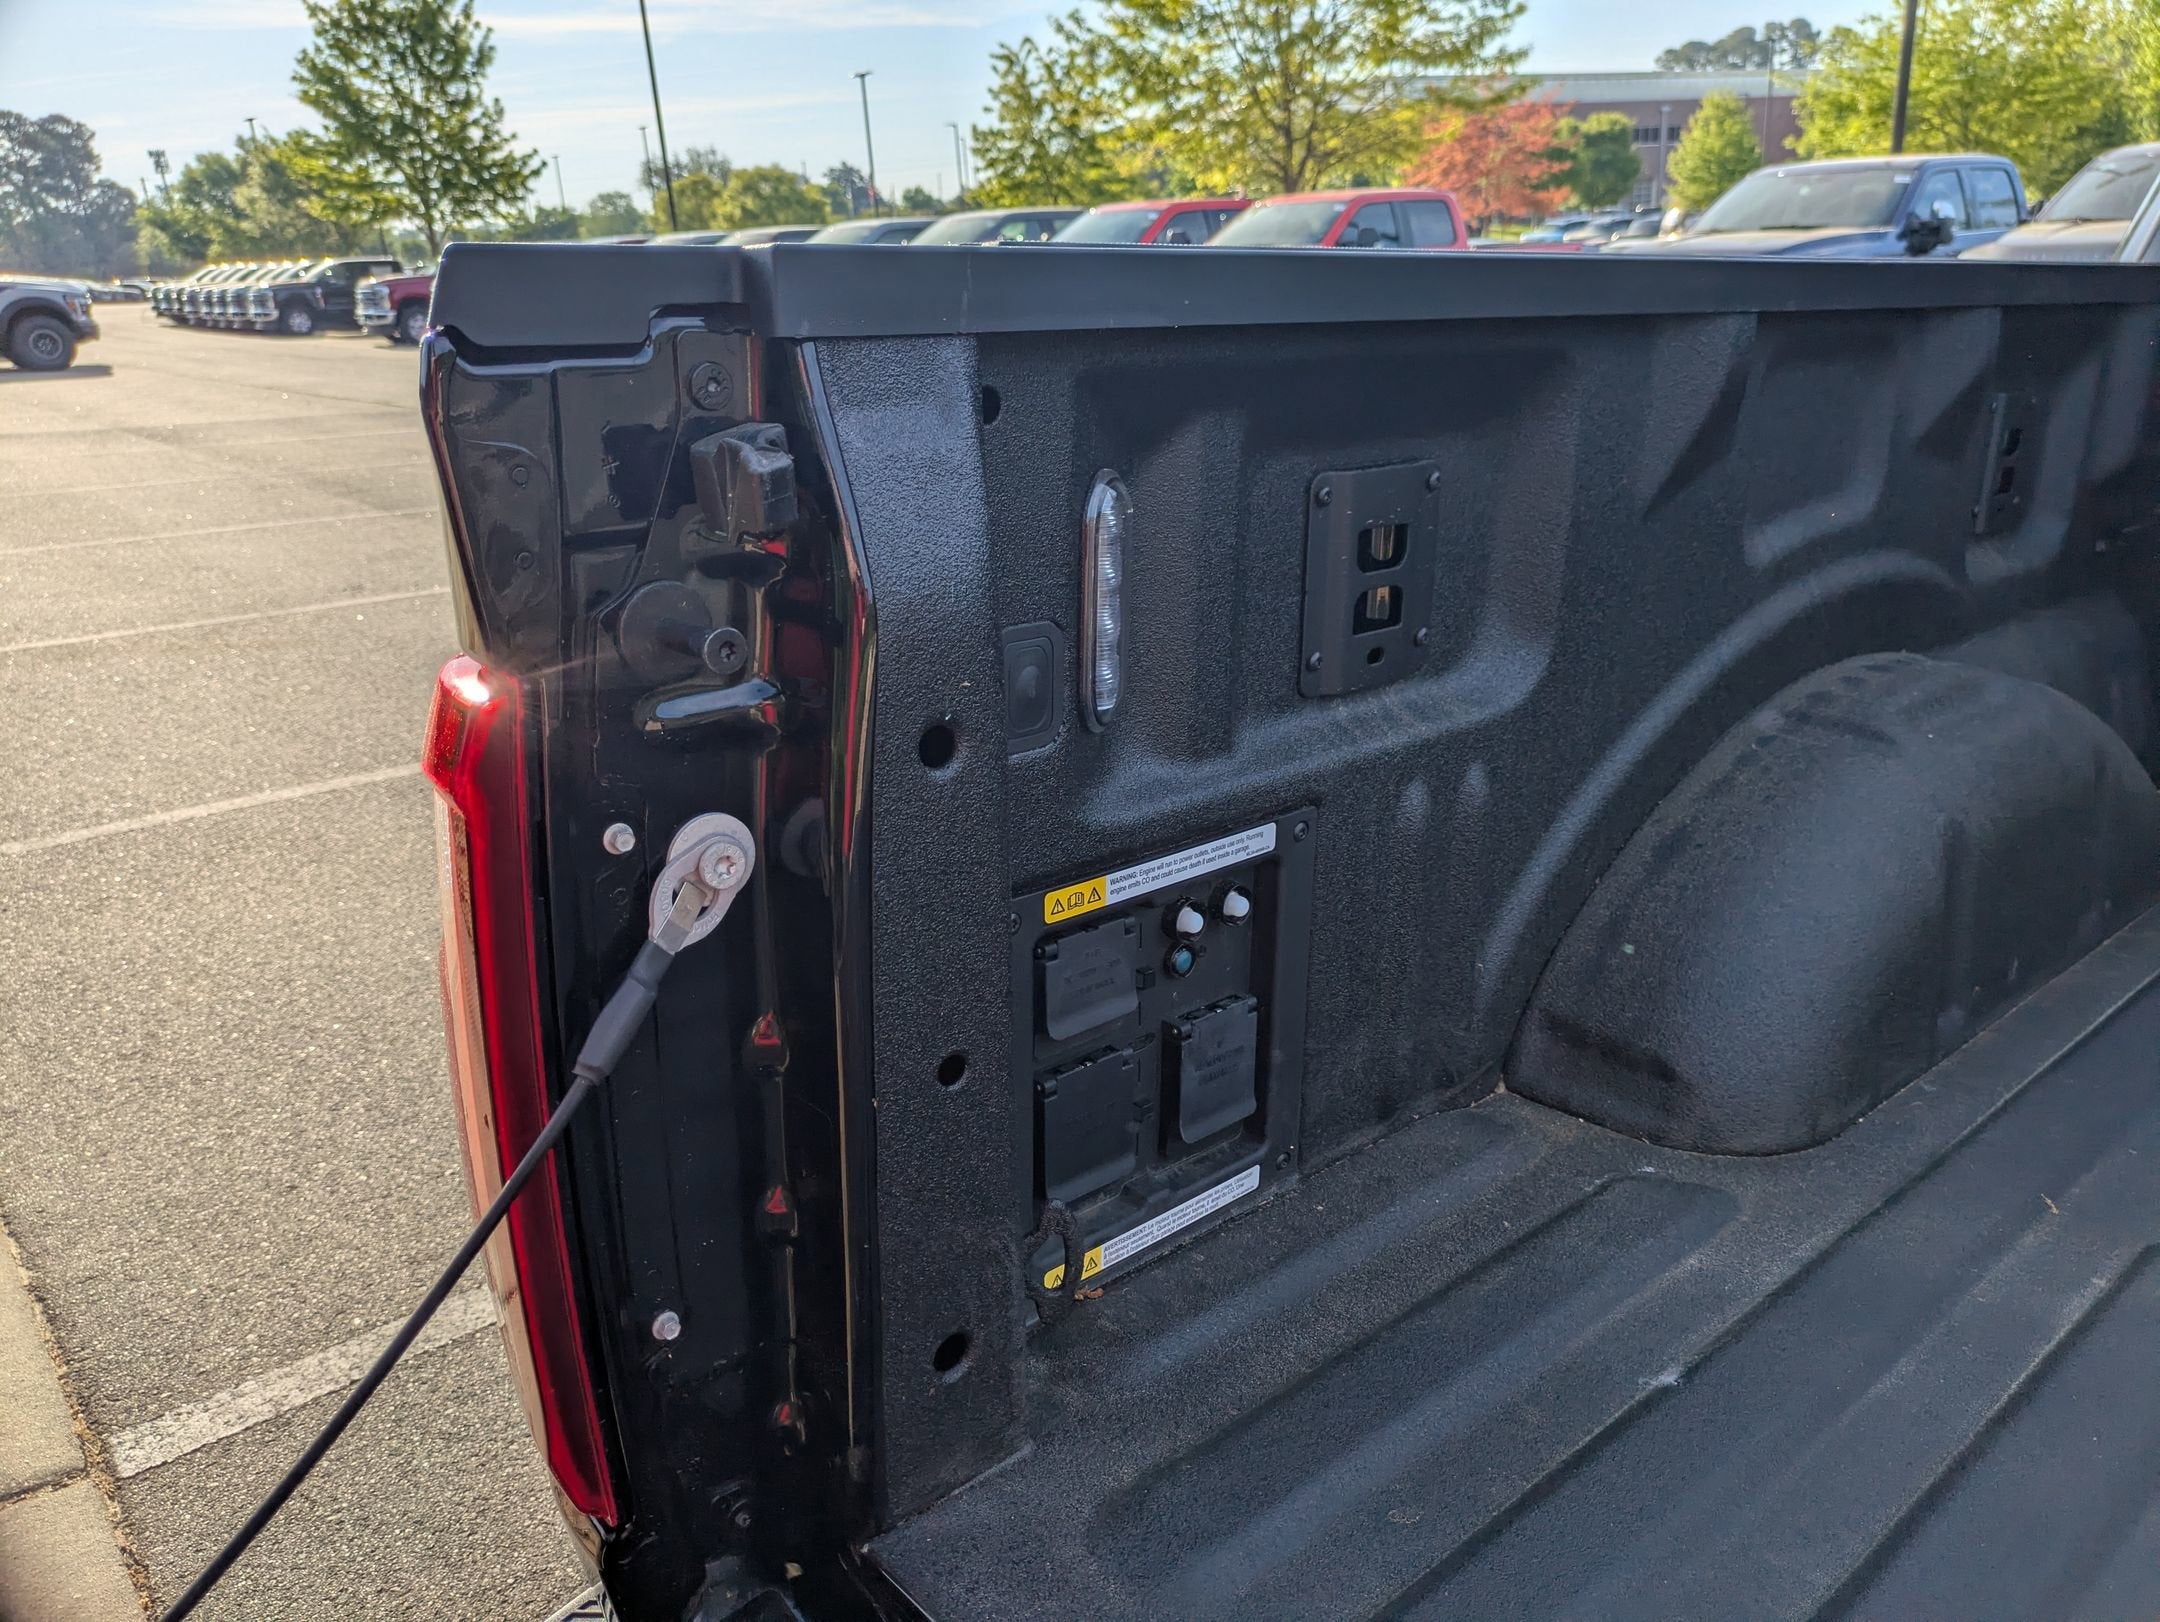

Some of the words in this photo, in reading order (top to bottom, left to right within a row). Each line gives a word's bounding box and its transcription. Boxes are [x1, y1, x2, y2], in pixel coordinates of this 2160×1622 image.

[1110, 871, 1138, 886] WARNING:
[1139, 866, 1155, 877] Engine
[1156, 861, 1164, 870] will
[1165, 860, 1173, 868] run
[1179, 854, 1193, 865] power
[1210, 843, 1226, 854] outside
[1227, 840, 1235, 848] use
[1246, 831, 1263, 841] Running
[1110, 885, 1127, 895] engine
[1127, 880, 1140, 890] emits
[1141, 876, 1150, 885] CO
[1150, 873, 1160, 882] and
[1160, 869, 1173, 879] could
[1173, 864, 1188, 875] cause
[1188, 859, 1202, 869] death
[1205, 854, 1217, 864] used
[1217, 851, 1230, 860] inside
